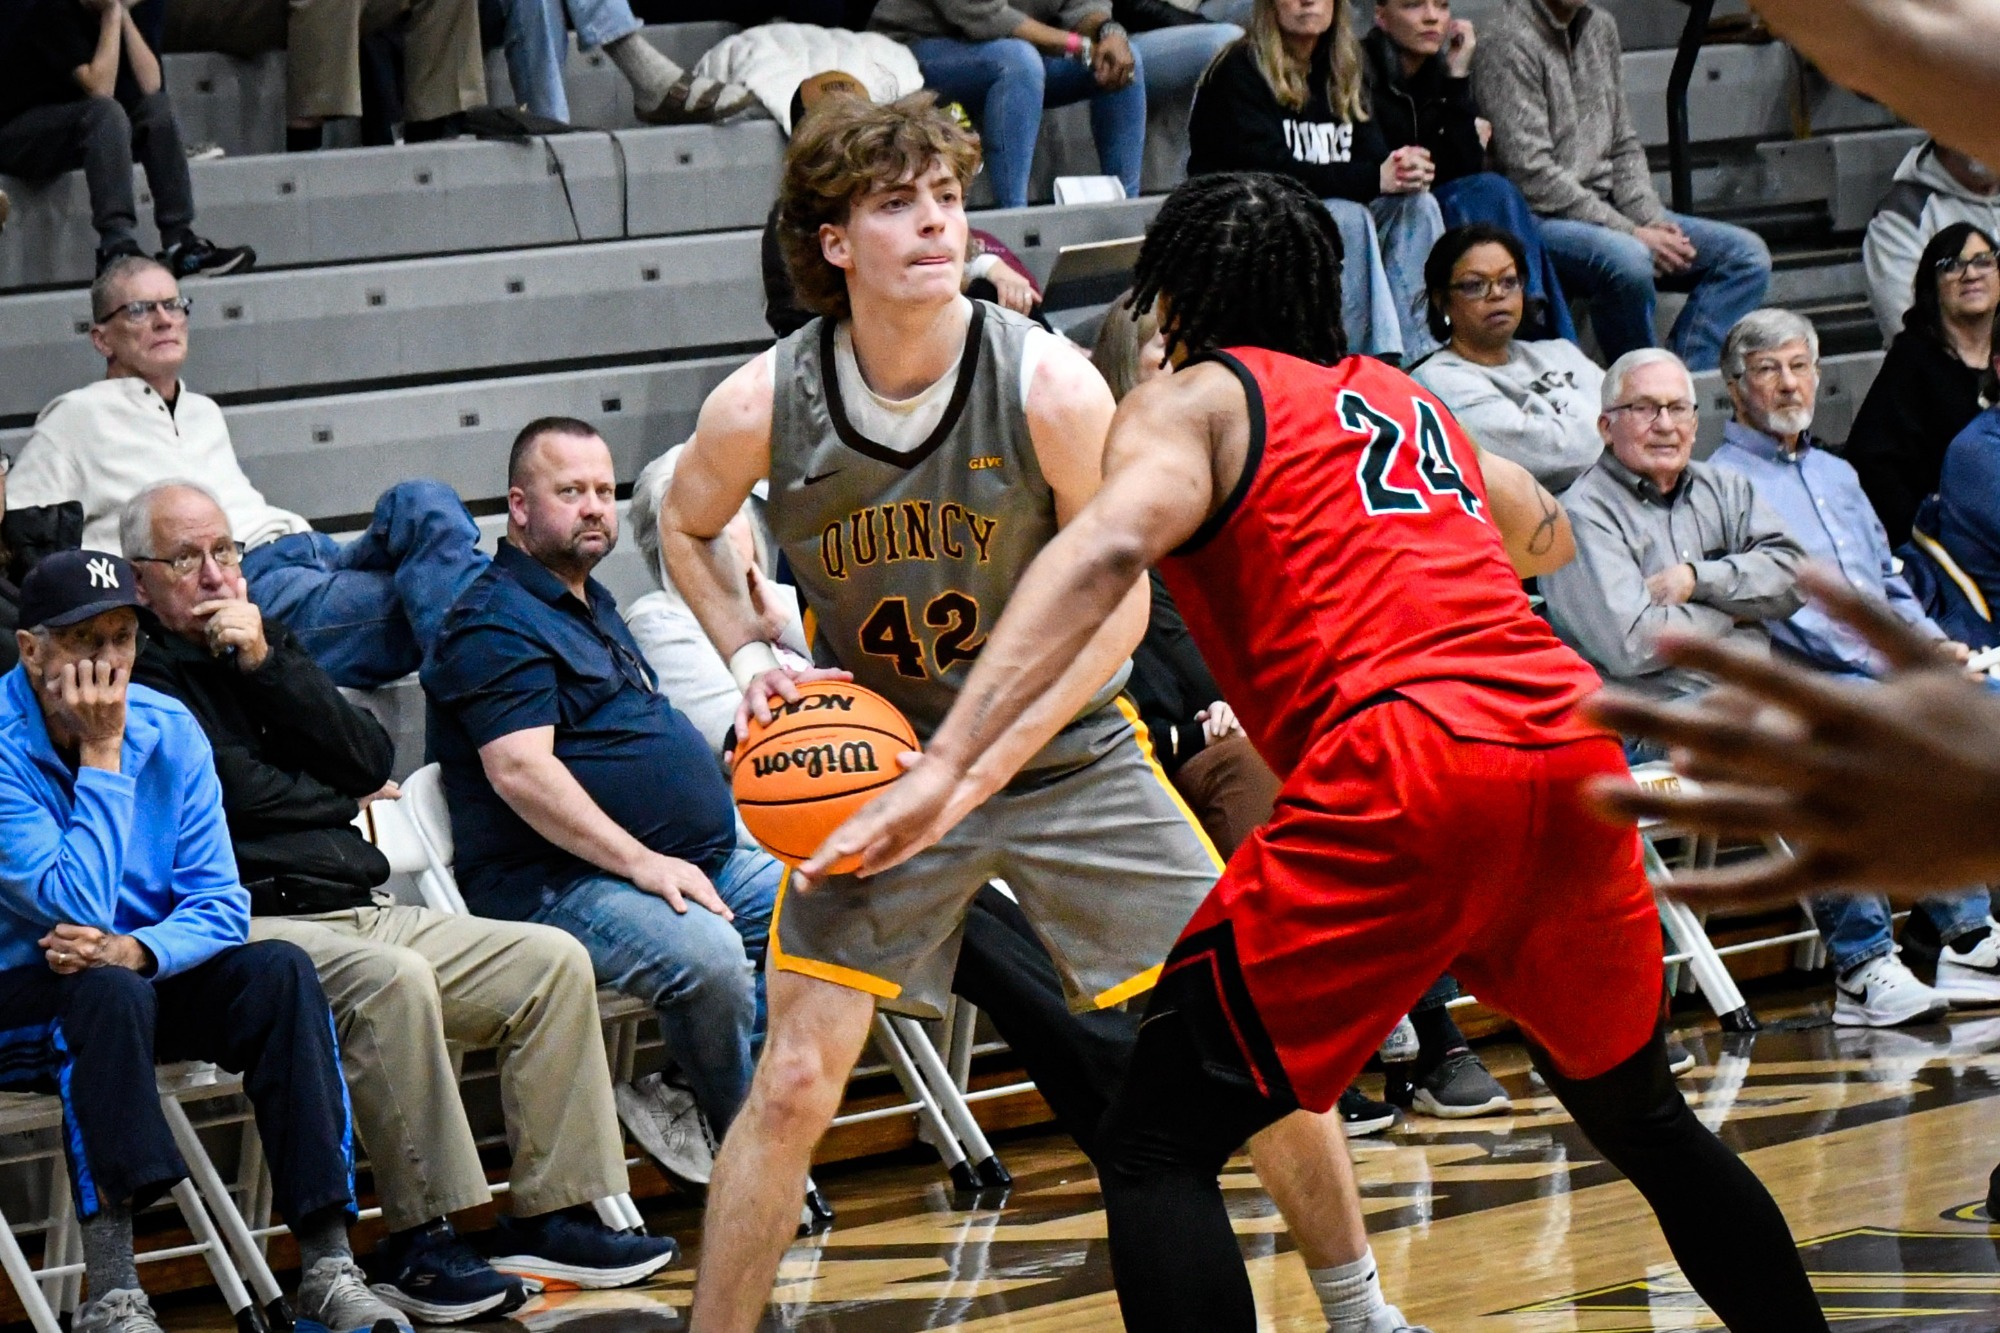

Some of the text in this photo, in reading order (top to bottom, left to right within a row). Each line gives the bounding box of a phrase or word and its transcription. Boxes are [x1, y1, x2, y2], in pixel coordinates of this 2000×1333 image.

[1335, 389, 1487, 524] 24
[820, 499, 998, 580] QUINCY
[858, 589, 990, 680] 42
[751, 739, 879, 779] Wilson
